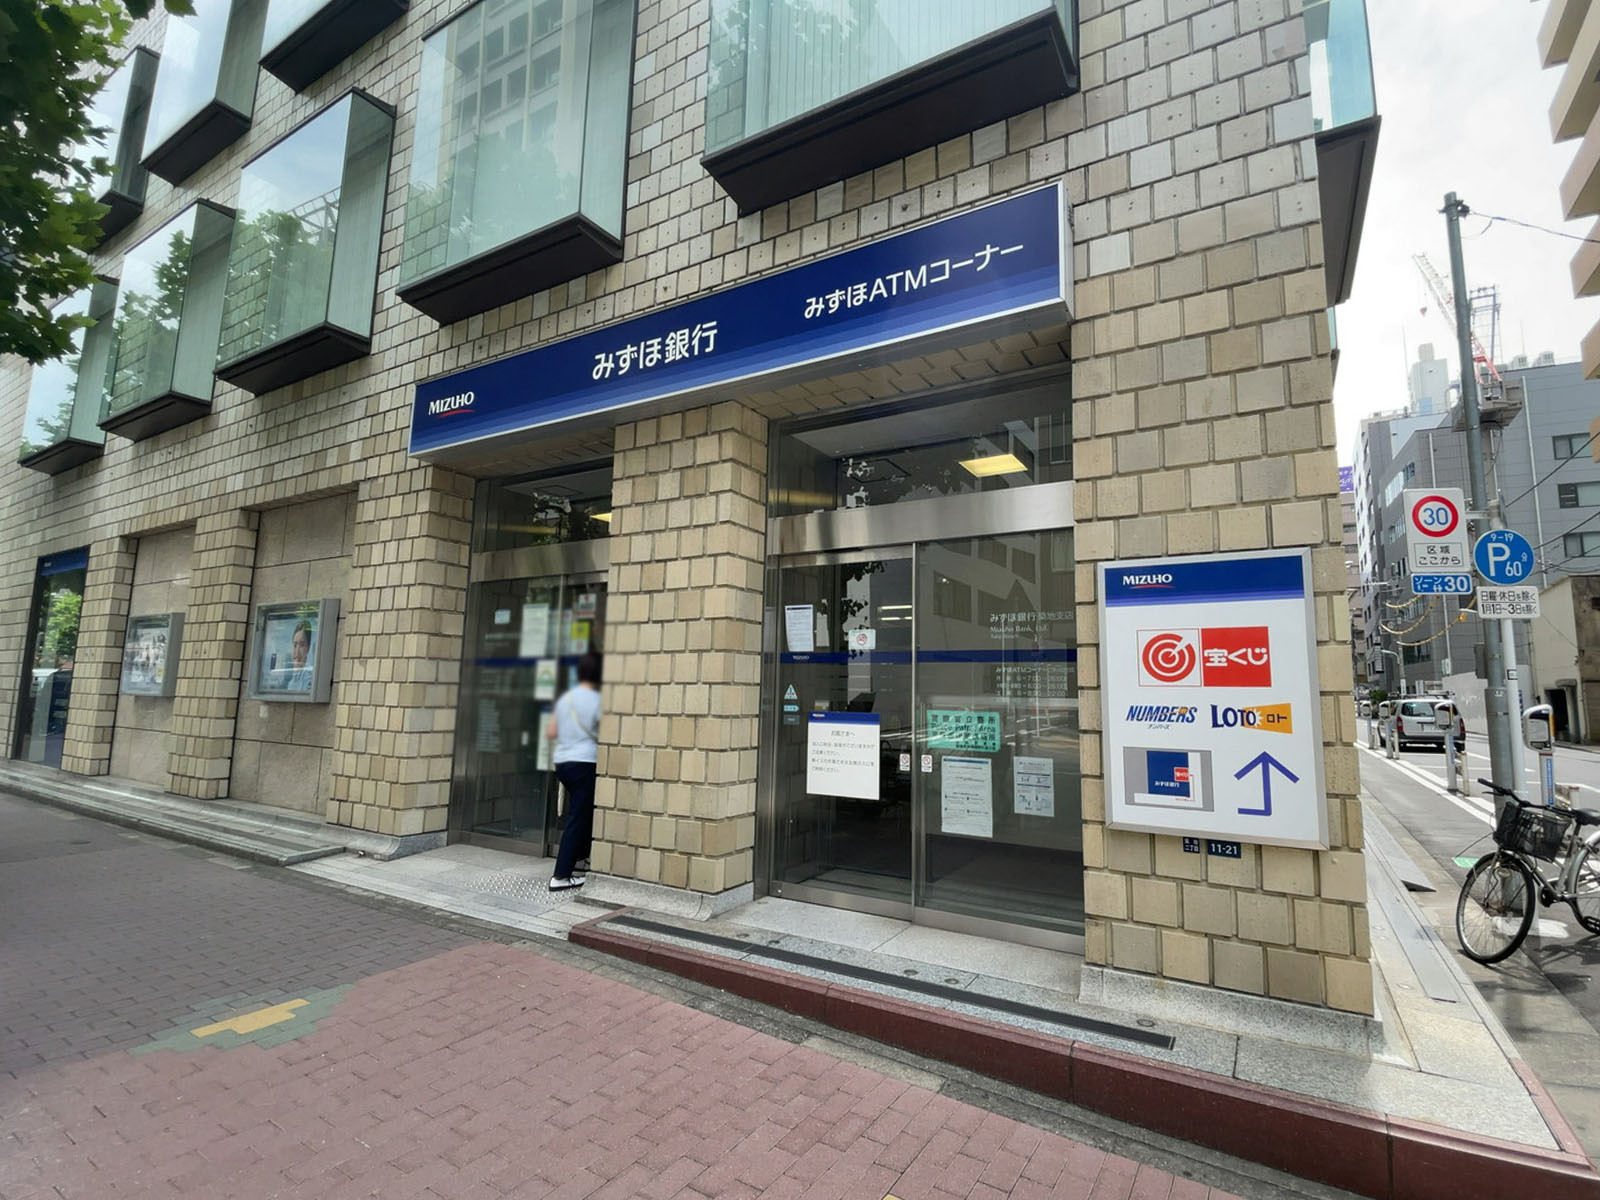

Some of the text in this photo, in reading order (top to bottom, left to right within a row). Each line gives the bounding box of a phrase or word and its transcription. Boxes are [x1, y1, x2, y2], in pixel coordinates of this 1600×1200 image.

[804, 243, 1024, 319] みずほATMコーナー
[592, 321, 718, 380] みずほ銀行
[428, 391, 475, 416] MIZUHO
[1423, 507, 1449, 526] 30
[1490, 533, 1514, 542] 9-19
[1427, 545, 1450, 554] 区域
[1418, 556, 1461, 565] ここから
[1487, 542, 1511, 577] P
[1505, 561, 1523, 577] 60
[1122, 573, 1173, 586] MIZUHO
[1204, 647, 1269, 667] 宝くじ
[1125, 704, 1288, 728] NUMBERS LOTO ロト
[1211, 843, 1238, 855] 11-21
